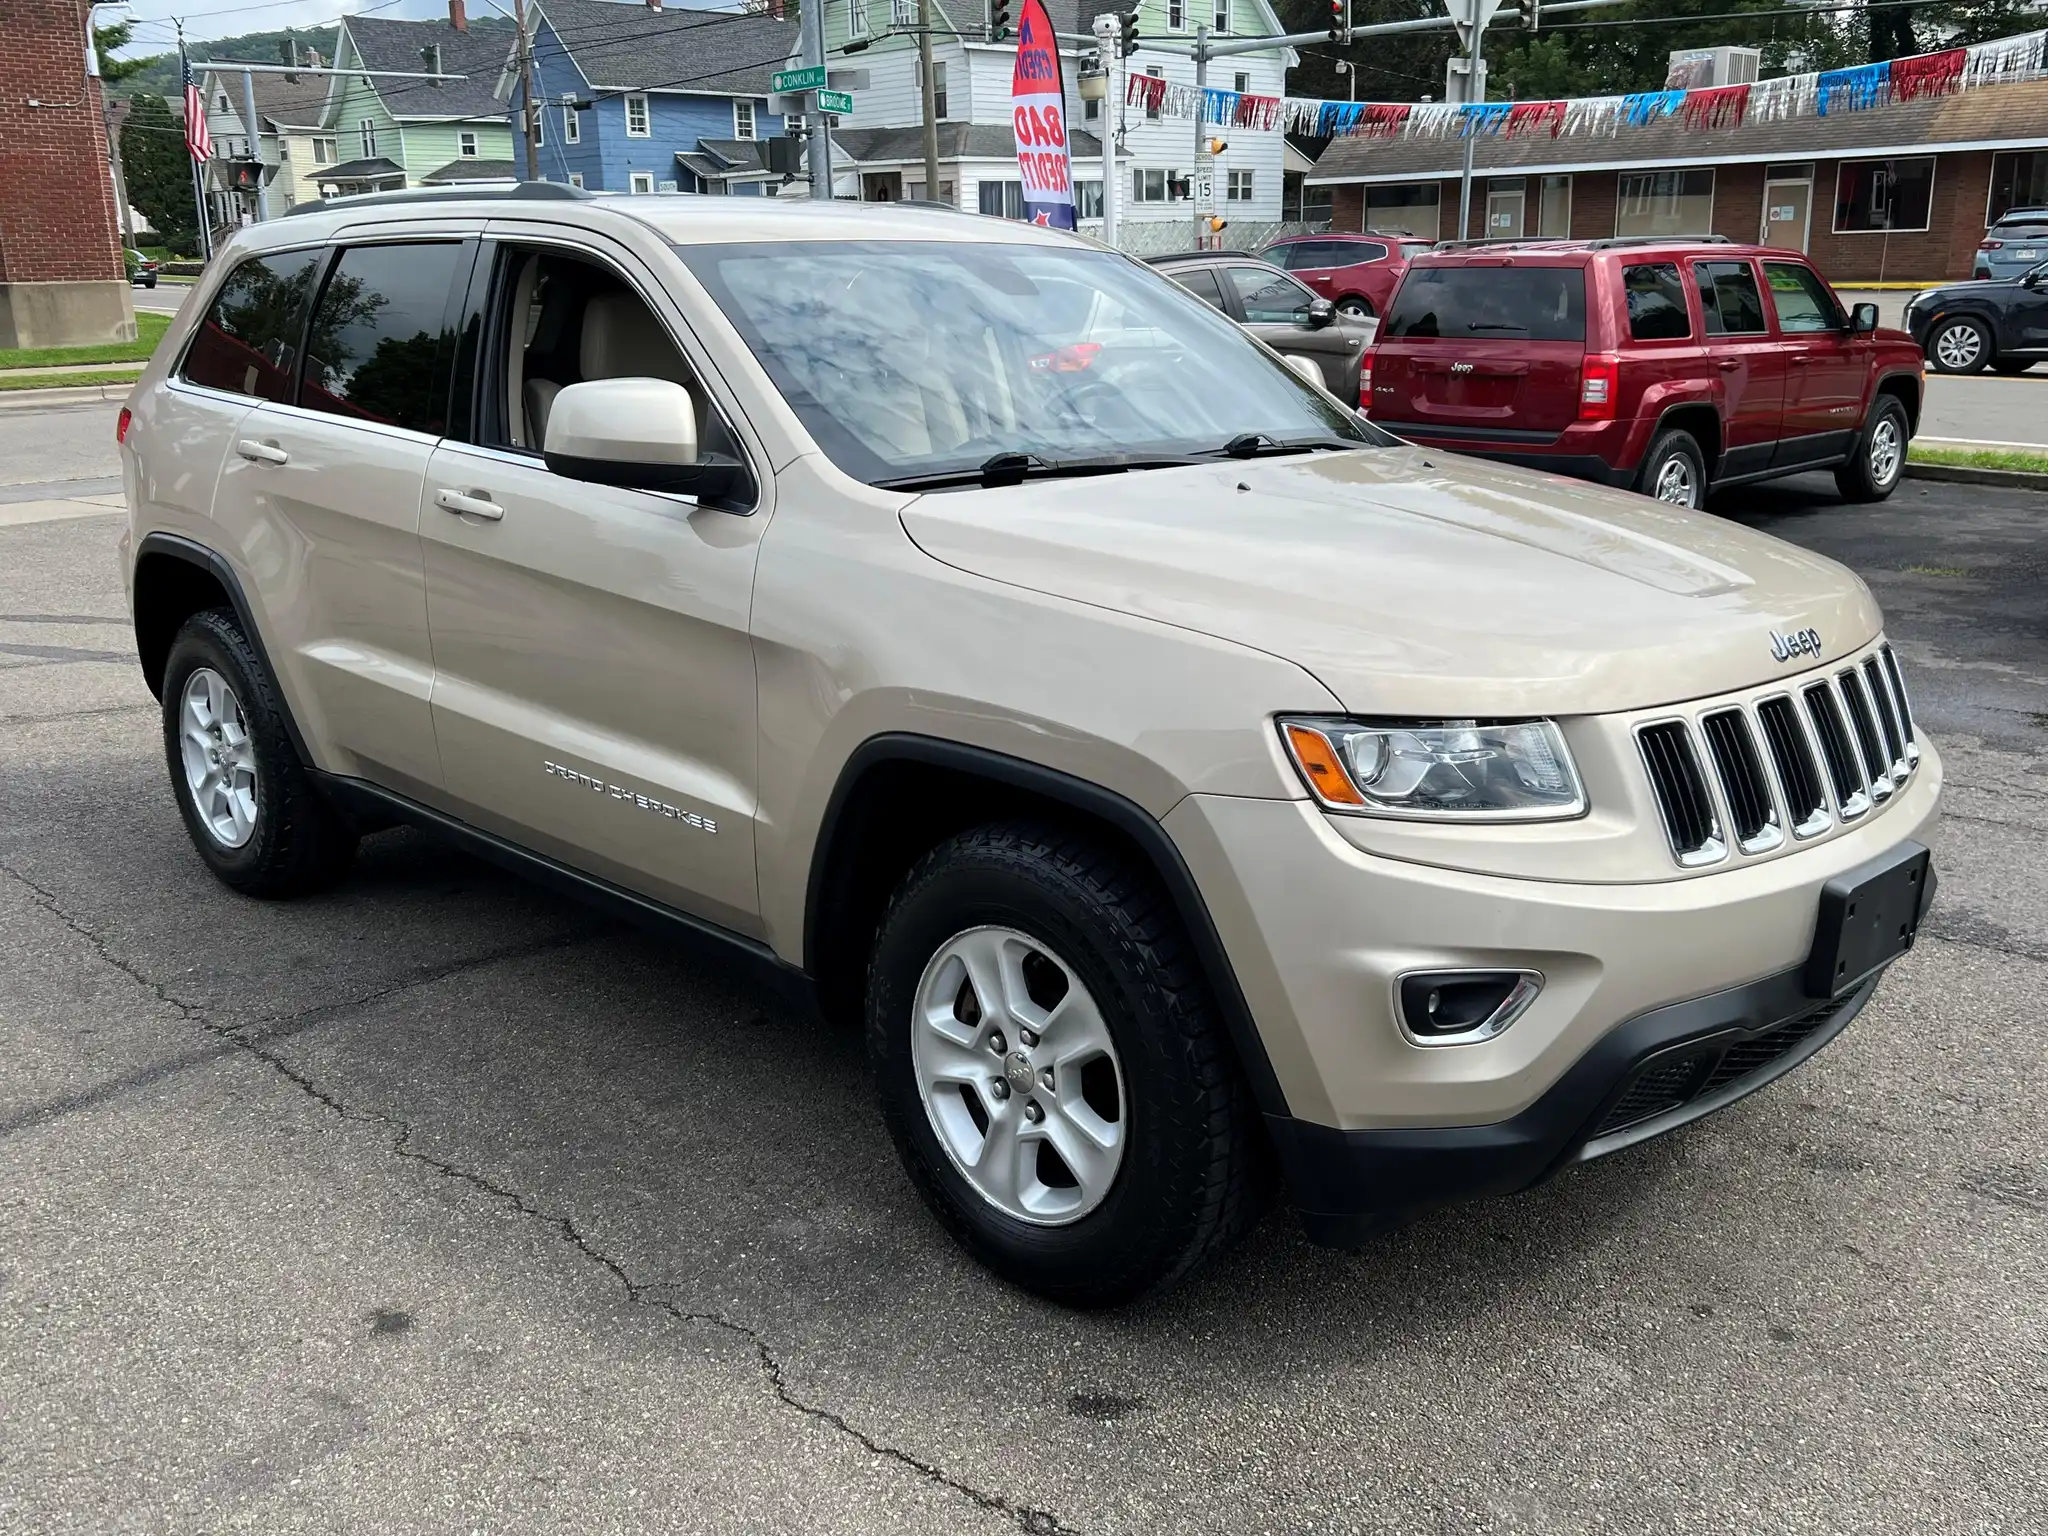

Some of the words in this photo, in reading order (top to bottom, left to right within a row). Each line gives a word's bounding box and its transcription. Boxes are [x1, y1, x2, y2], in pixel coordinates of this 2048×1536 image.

[782, 71, 815, 88] CONKLIN
[816, 75, 825, 83] AVE
[825, 94, 847, 110] BROOME
[1196, 166, 1213, 174] SPEED
[1197, 174, 1212, 182] LIMIT
[1198, 182, 1211, 198] 15
[1450, 361, 1474, 374] Jeep
[1769, 627, 1822, 663] Jeep
[544, 760, 606, 793] GRAND
[608, 784, 718, 834] CHEROKEE
